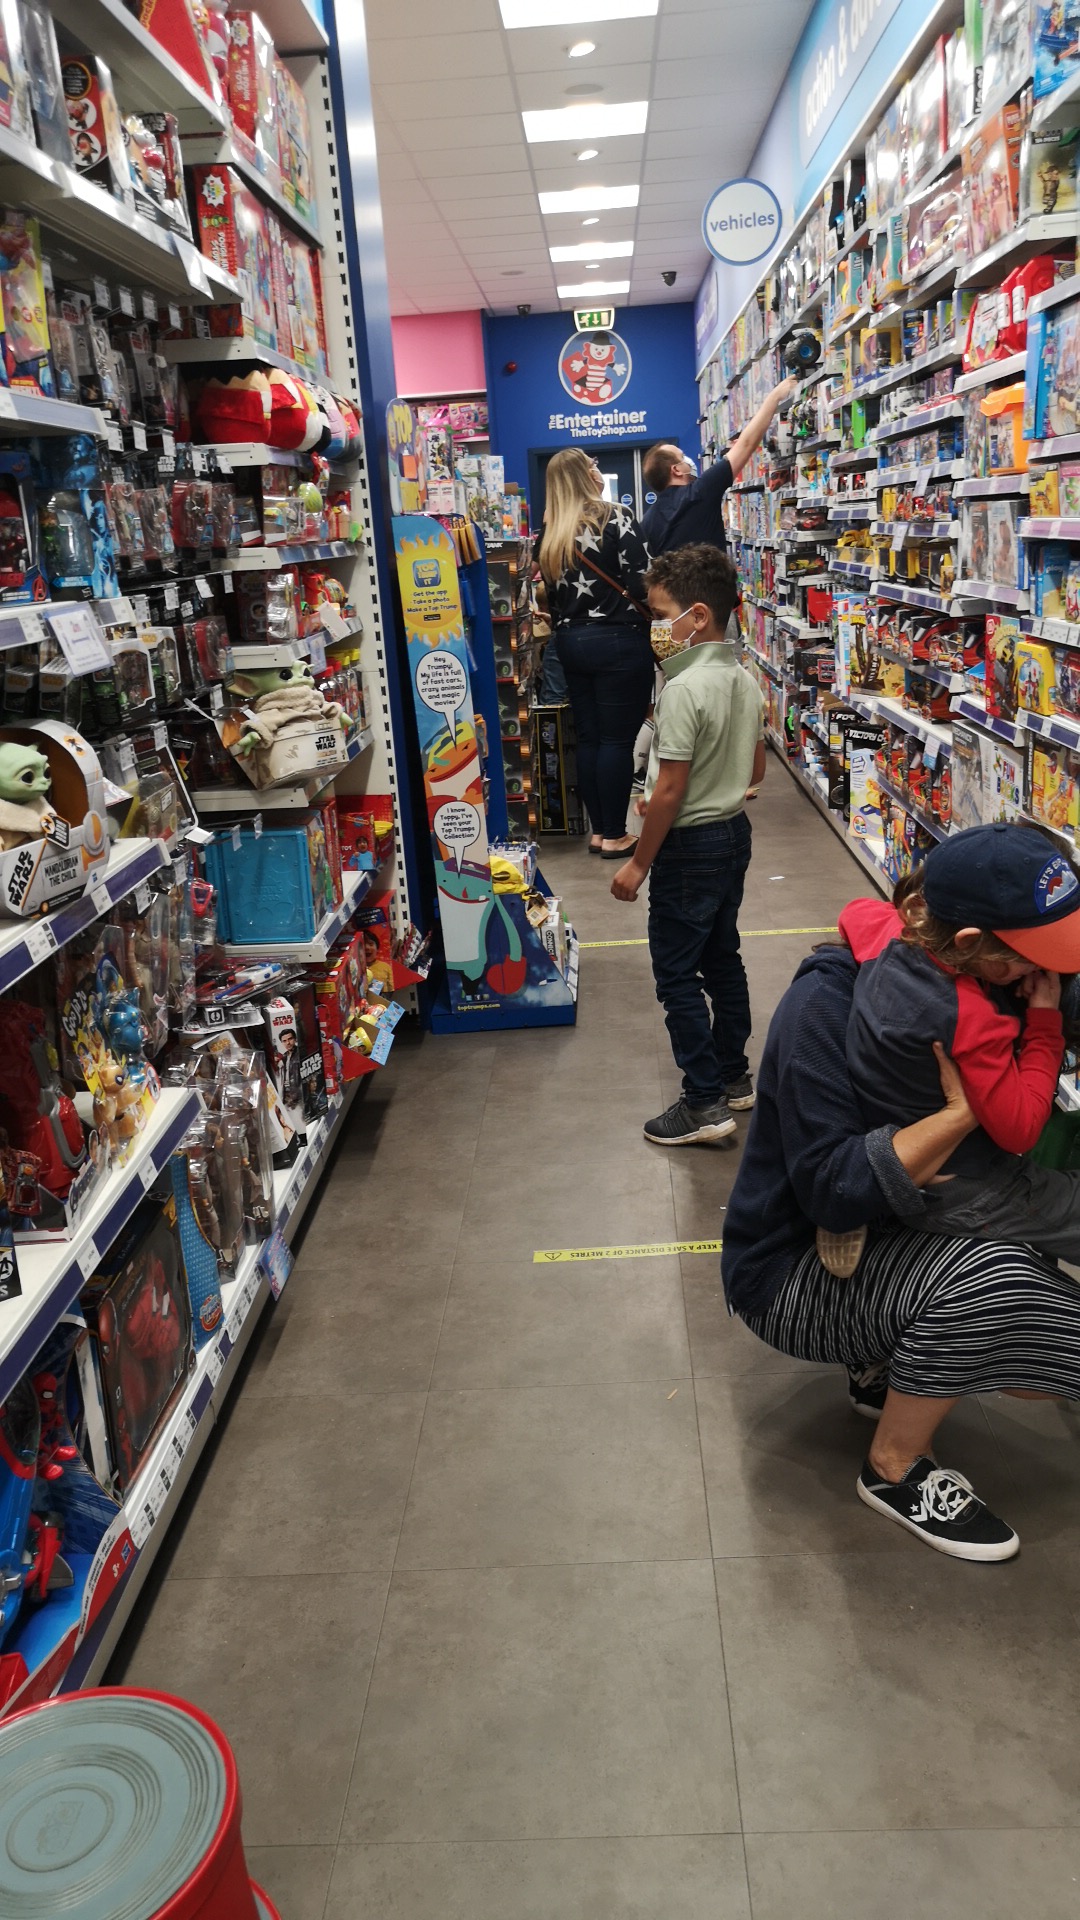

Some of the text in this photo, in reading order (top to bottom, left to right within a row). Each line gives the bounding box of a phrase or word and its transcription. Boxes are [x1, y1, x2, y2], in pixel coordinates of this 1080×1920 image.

[837, 5, 848, 77] &
[710, 211, 775, 232] vehicles
[555, 408, 647, 429] Entertainer
[570, 425, 647, 437] TheToyShop.com
[433, 597, 450, 605] photo
[431, 670, 443, 678] life
[450, 668, 462, 676] full
[441, 691, 461, 699] magic
[315, 734, 336, 744] STAR
[316, 741, 336, 751] WARS
[8, 851, 32, 902] STAR
[11, 853, 34, 907] WARS
[49, 874, 61, 888] THE
[61, 868, 77, 883] CHILD
[1038, 866, 1054, 889] LET'S
[457, 1003, 501, 1011] toptrumps.com
[272, 1019, 293, 1027] WARS
[300, 1053, 322, 1071] STAR
[300, 1060, 323, 1079] WARS
[570, 1251, 603, 1259] METRES
[624, 1246, 665, 1255] DISTANCE
